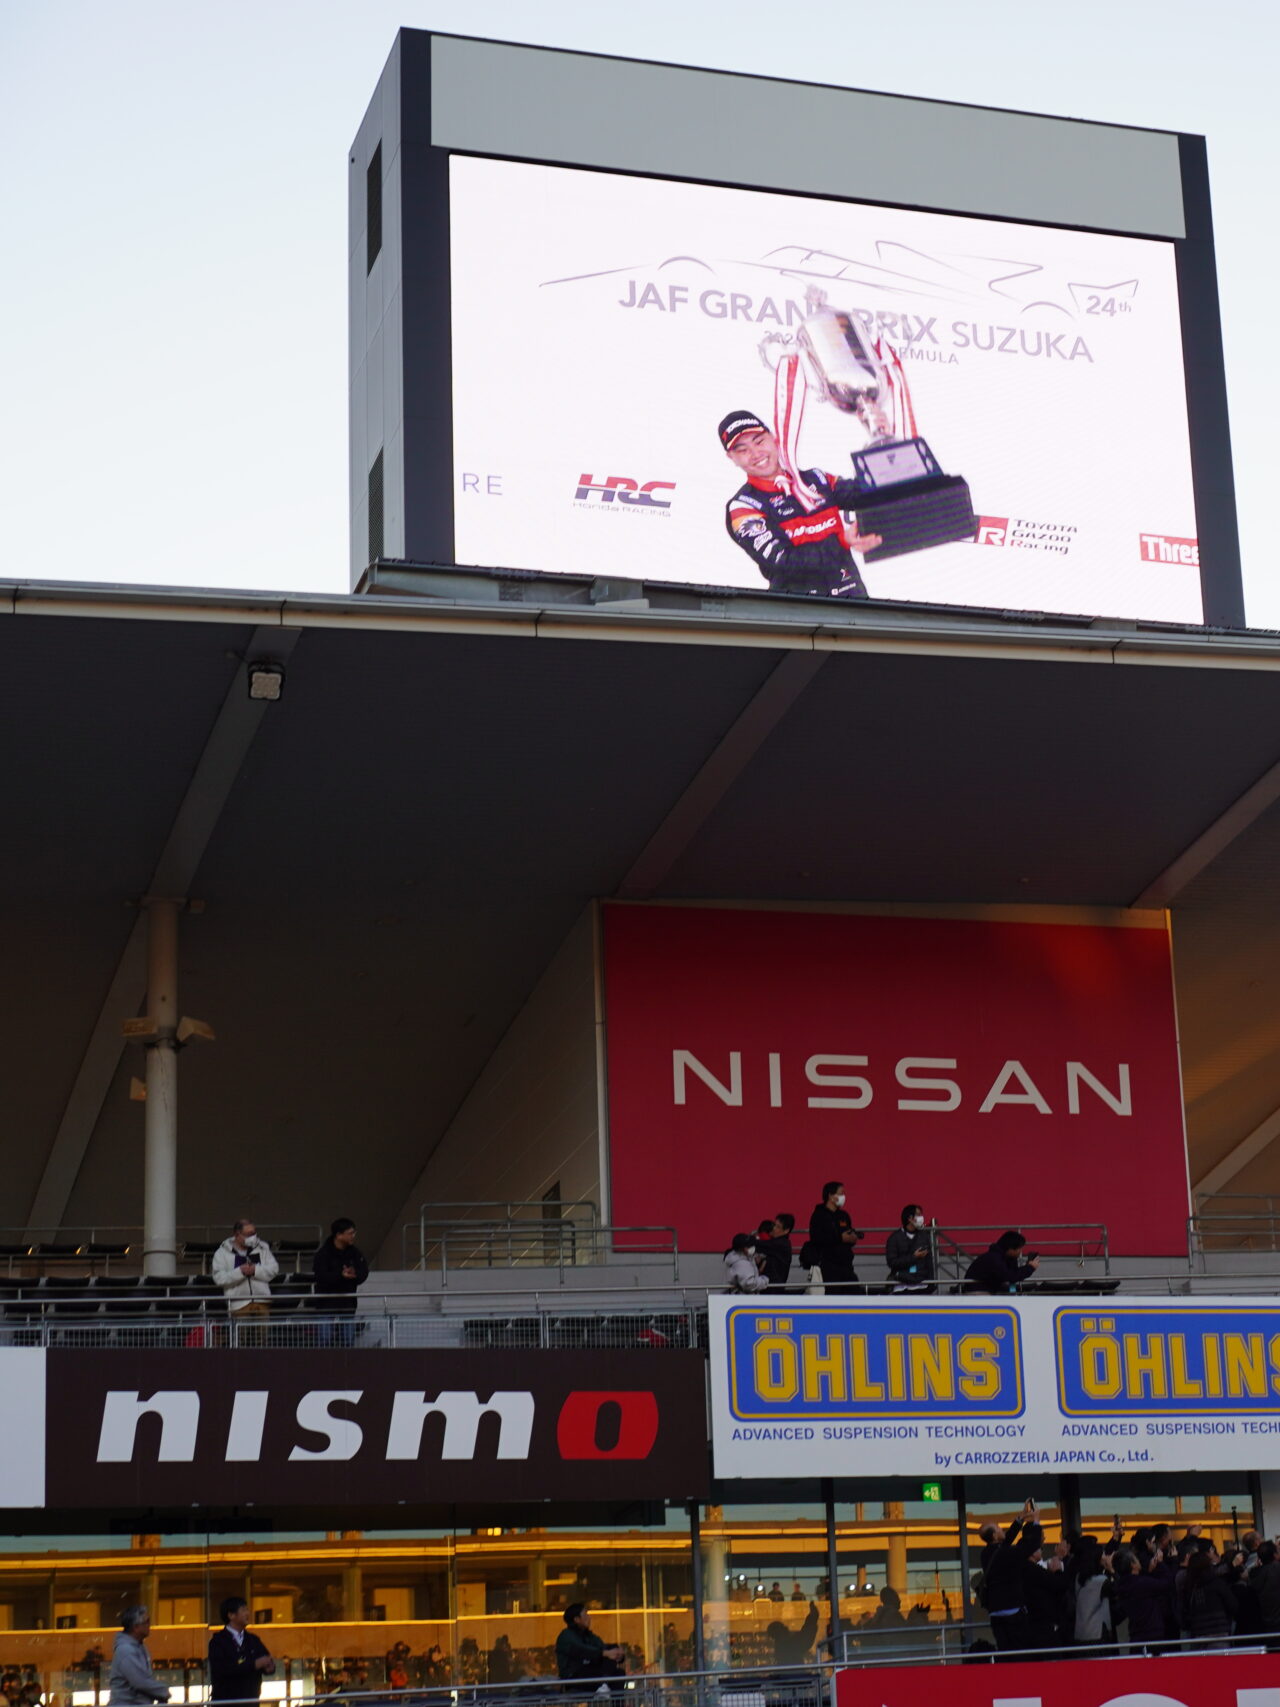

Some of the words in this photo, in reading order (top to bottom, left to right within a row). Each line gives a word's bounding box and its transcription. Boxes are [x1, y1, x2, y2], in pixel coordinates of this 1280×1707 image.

[1085, 295, 1132, 317] 24th
[618, 280, 689, 312] JAF
[699, 289, 813, 326] GRAN
[951, 321, 1095, 363] SUZUKA
[764, 330, 793, 344] 202
[891, 346, 960, 365] RMULA
[463, 473, 503, 496] RE
[574, 474, 677, 508] HRC
[572, 502, 620, 513] Honda
[1011, 529, 1072, 544] GAZOO
[1013, 519, 1078, 534] TOYOTA
[1010, 539, 1069, 555] Racing
[673, 1049, 1133, 1117] NISSAN
[753, 1318, 1002, 1403] ÖHLINS
[96, 1390, 659, 1462] nismo
[732, 1428, 815, 1441] ADVANCED
[823, 1426, 919, 1440] SUSPENSION
[925, 1425, 1026, 1439] TECHNOLOGY
[1061, 1424, 1138, 1436] ADVANCED
[1146, 1422, 1235, 1435] SUSPENSION
[935, 1453, 951, 1466] by
[954, 1452, 1050, 1464] CARROZZERIA
[1053, 1451, 1095, 1463] JAPAN
[1128, 1449, 1154, 1462] Ltd.
